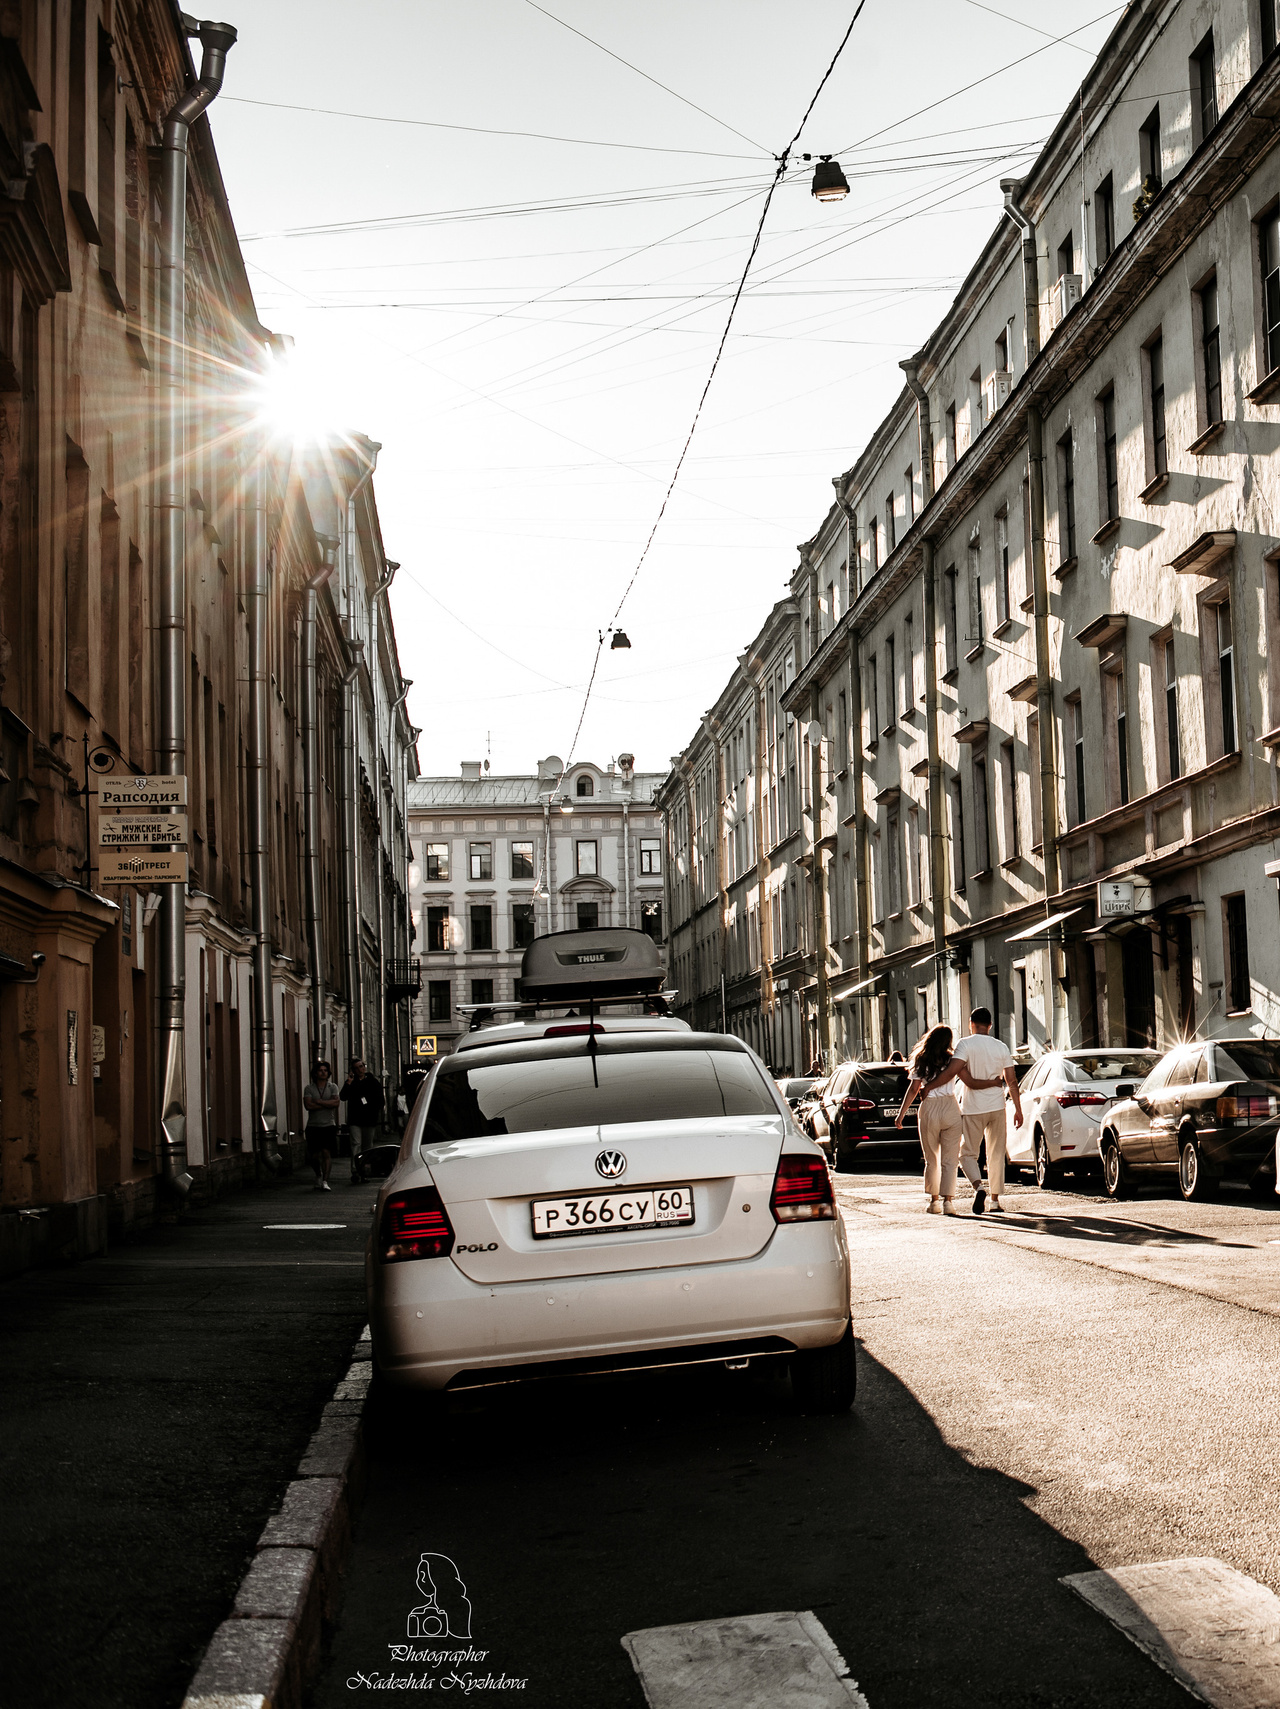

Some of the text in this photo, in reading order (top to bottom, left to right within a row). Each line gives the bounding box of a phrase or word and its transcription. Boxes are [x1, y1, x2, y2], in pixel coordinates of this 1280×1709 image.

[103, 792, 180, 804] Рапсодия
[121, 824, 162, 833] МУЖСКИЕ
[102, 832, 182, 843] СТРИЖКИ И БРИТЬЕ
[144, 861, 171, 870] ТРЕСТ
[1104, 903, 1132, 912] ЦИРК
[577, 954, 605, 963] THULE
[657, 1191, 683, 1211] 60
[656, 1211, 677, 1219] RUS
[456, 1242, 499, 1254] POLO
